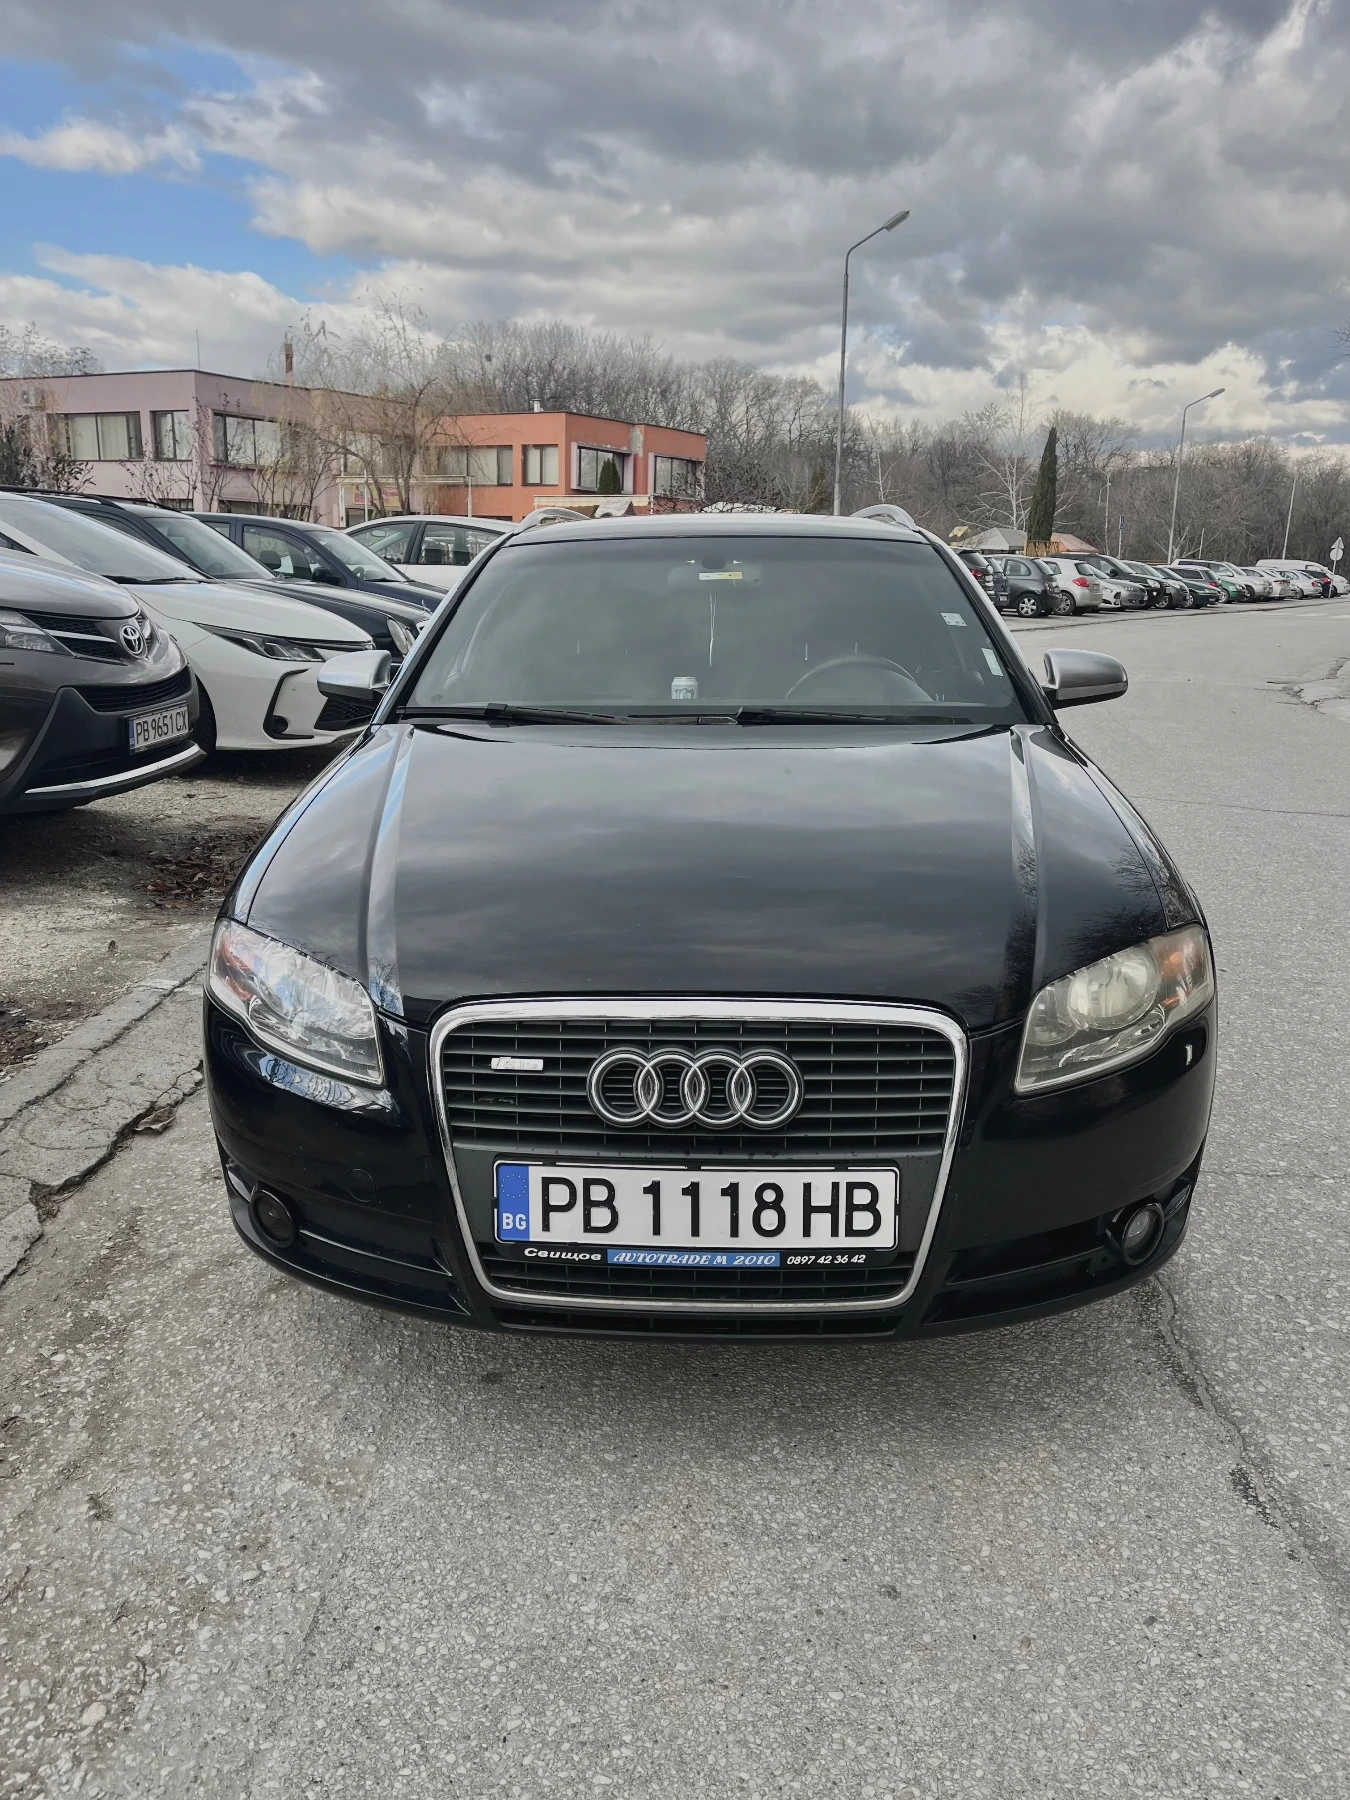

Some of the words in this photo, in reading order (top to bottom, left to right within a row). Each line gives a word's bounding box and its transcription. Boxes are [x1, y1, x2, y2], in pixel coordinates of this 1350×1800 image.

[135, 720, 150, 745] PB
[151, 714, 174, 740] 9651
[175, 710, 187, 732] CX
[540, 1176, 620, 1234] PB
[642, 1179, 787, 1238] 1118
[801, 1181, 883, 1238] HB
[501, 1212, 527, 1231] BG
[523, 1247, 602, 1262] Свищов
[613, 1251, 710, 1266] AUTOTRADE
[712, 1255, 729, 1266] M
[733, 1254, 776, 1266] 2010
[786, 1255, 816, 1266] 0897
[817, 1255, 832, 1265] 42
[833, 1254, 850, 1265] 36
[851, 1254, 867, 1264] 42
